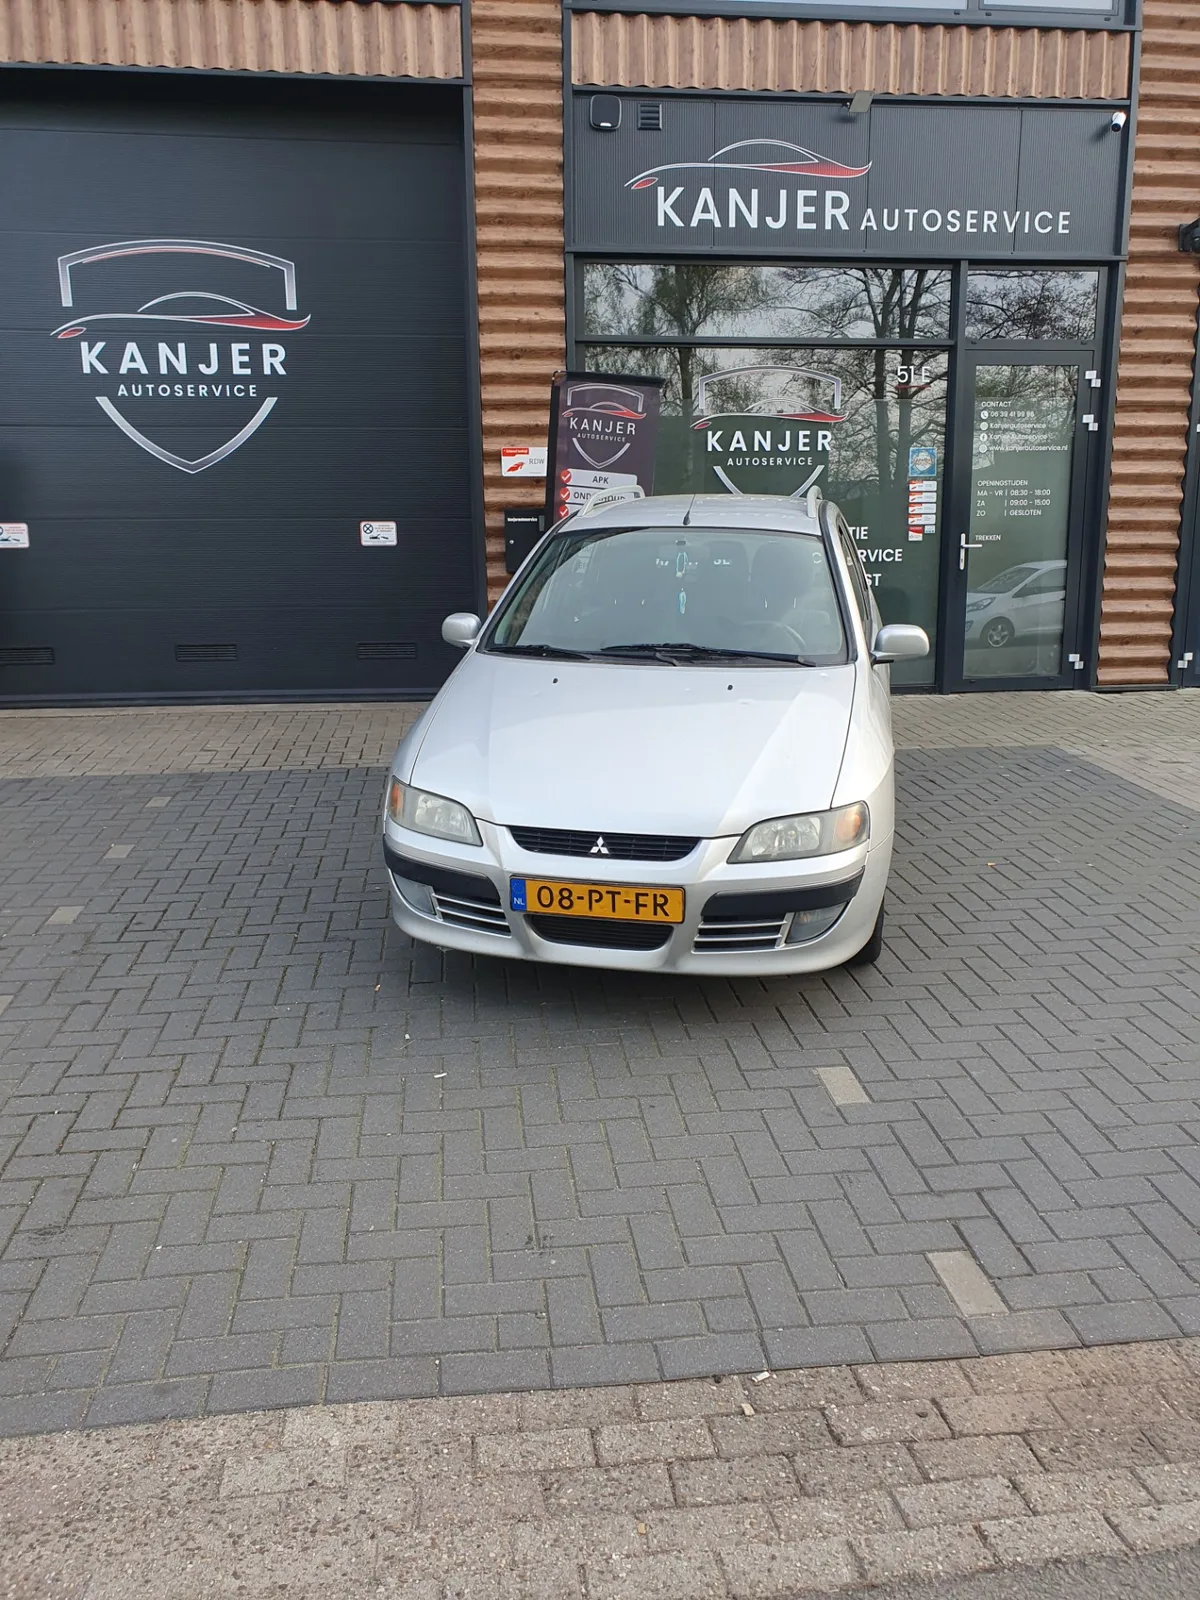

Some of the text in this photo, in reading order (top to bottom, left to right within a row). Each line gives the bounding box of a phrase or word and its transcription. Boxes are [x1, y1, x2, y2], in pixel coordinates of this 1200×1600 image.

[656, 185, 1071, 234] KANJER AUTOSERVICE
[80, 341, 288, 375] KANJER
[897, 366, 914, 383] 51
[118, 384, 258, 397] AUTOSERVICE
[569, 417, 636, 435] KANJER
[577, 433, 626, 443] AUTOSERVICE
[706, 430, 833, 451] KANJER
[529, 457, 545, 465] RDW
[727, 456, 813, 466] AUTOSERVICE
[592, 475, 609, 484] APK
[849, 526, 869, 540] TIE
[858, 548, 903, 562] RVICE
[513, 897, 526, 906] NL
[536, 885, 670, 917] 08-PT-FR
